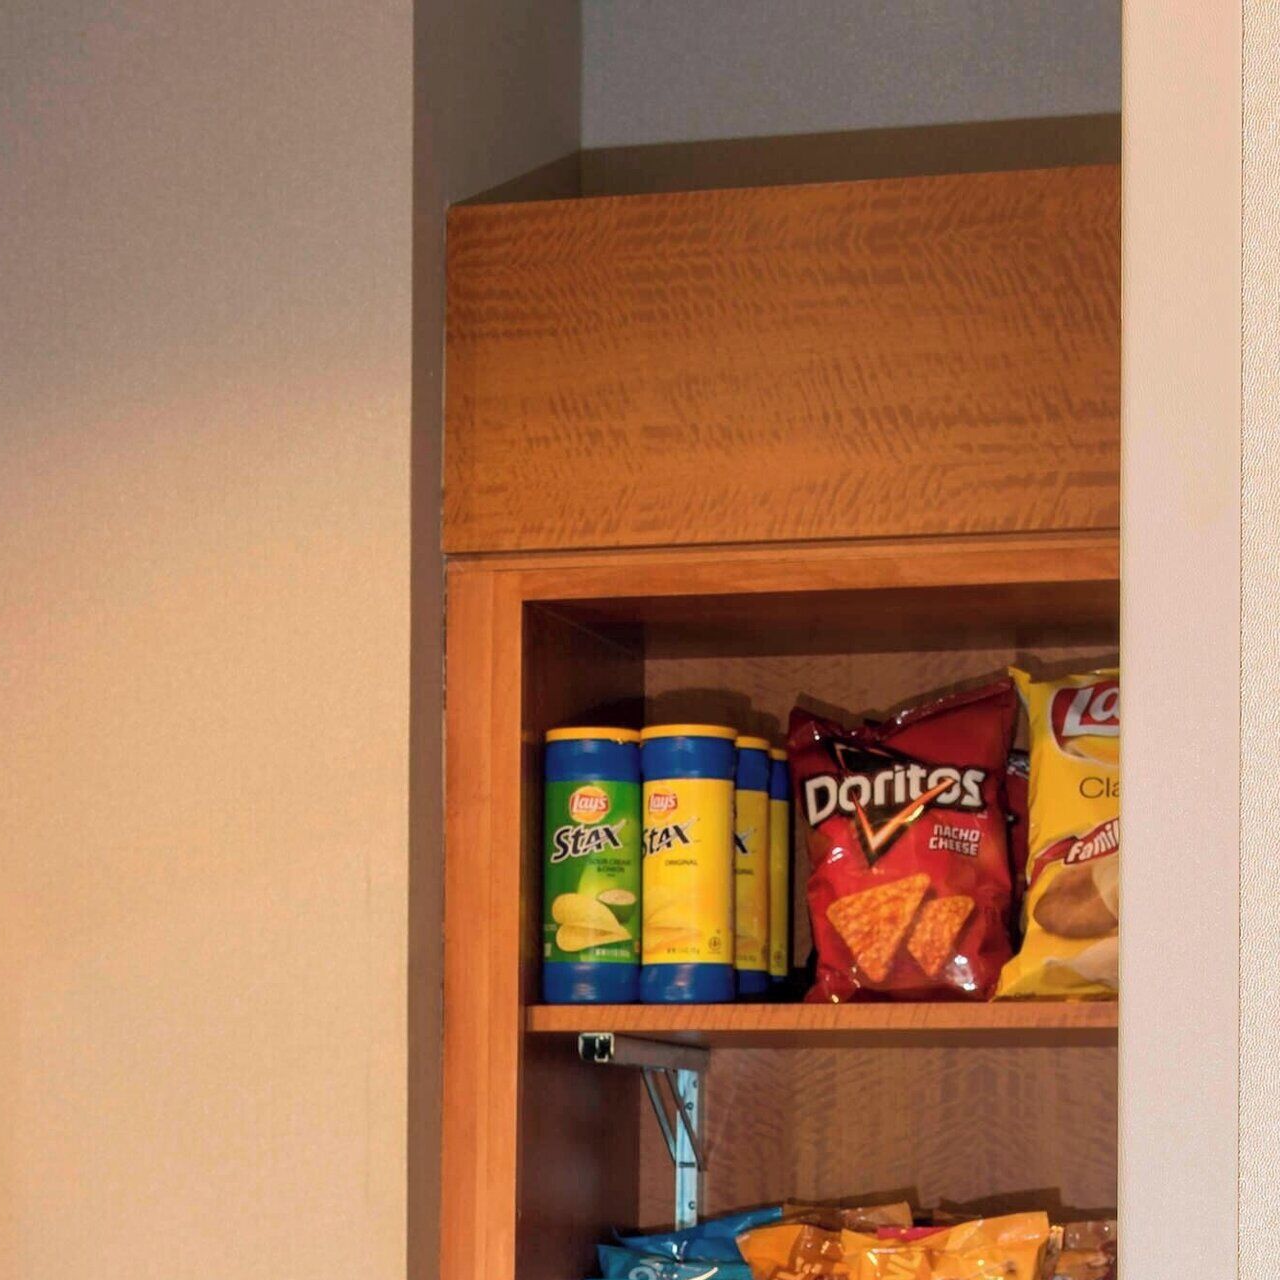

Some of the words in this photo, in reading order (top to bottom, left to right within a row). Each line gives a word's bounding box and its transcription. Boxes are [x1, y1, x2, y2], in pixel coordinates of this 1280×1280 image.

[805, 769, 986, 827] Doritos
[933, 824, 980, 843] NACHO
[929, 836, 979, 857] CHEESE
